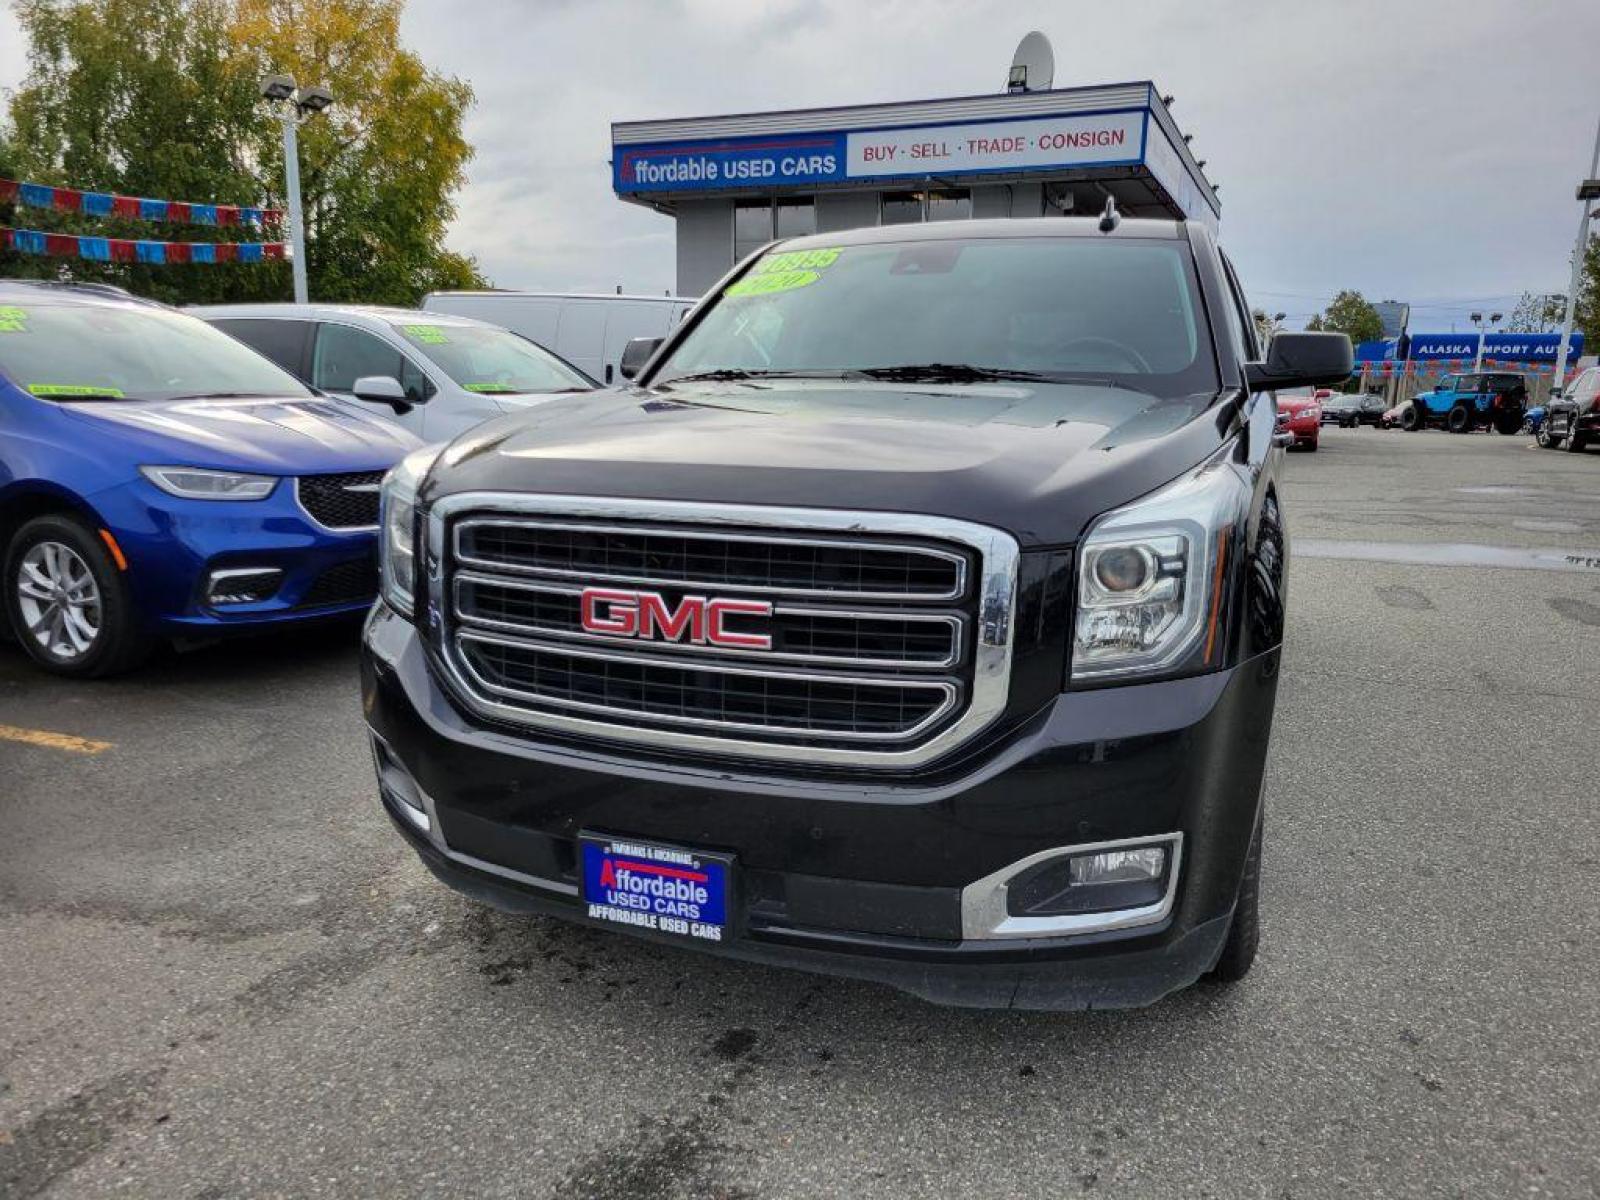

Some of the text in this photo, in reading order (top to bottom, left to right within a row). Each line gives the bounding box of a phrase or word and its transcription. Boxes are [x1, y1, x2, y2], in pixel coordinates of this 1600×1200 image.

[862, 129, 1125, 162] BUY SELL TRADE CONSIGN
[620, 152, 837, 184] Affordable USED CARS
[1418, 345, 1472, 354] ALASKA
[1479, 345, 1529, 354] MPORT
[581, 587, 773, 650] GMC
[600, 858, 709, 905] Affordable
[607, 890, 701, 919] USED CARS
[588, 904, 722, 942] AFFORDABLE USED CARS
